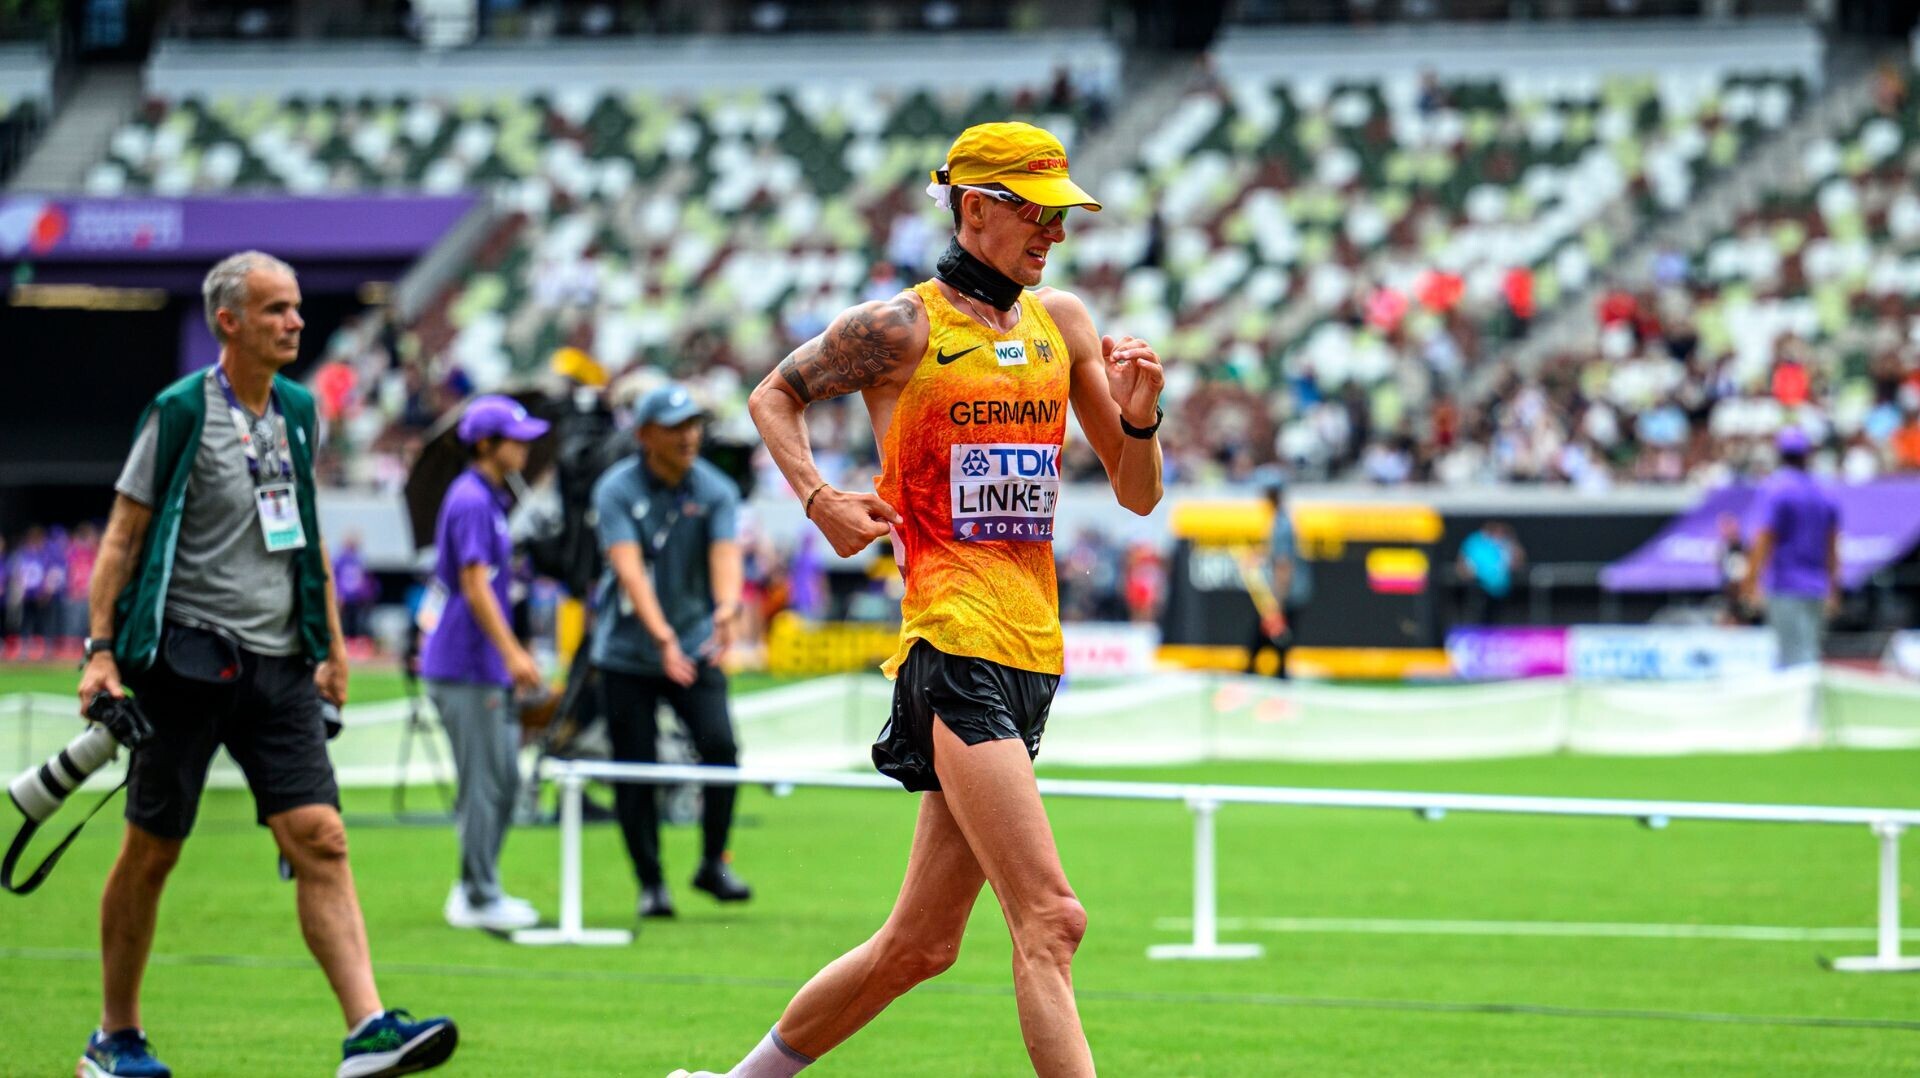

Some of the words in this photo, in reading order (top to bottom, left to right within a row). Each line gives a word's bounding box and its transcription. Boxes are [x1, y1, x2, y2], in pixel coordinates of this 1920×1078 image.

[996, 347, 1025, 360] WGV
[950, 400, 1062, 426] GERMANY
[989, 448, 1056, 477] TDK
[959, 484, 1041, 513] LINKE
